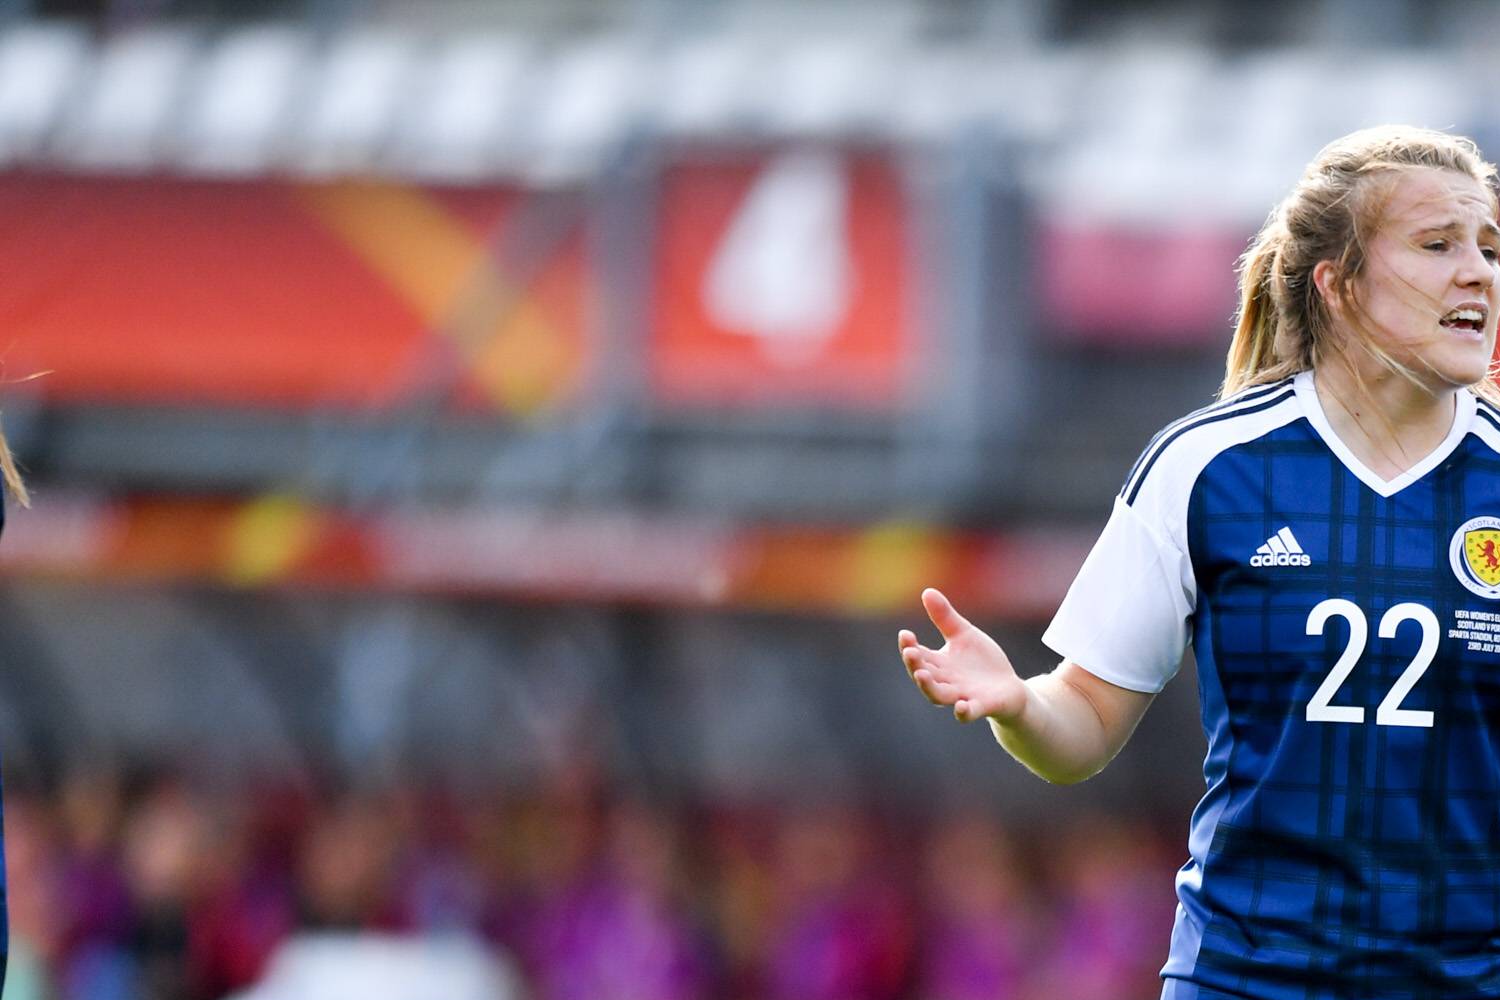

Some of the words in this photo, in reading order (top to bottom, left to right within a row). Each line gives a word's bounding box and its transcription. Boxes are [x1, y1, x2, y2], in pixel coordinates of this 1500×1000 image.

[1250, 552, 1311, 567] adidas
[1455, 610, 1469, 619] UEFA
[1457, 620, 1485, 631] SCOTLAND
[1448, 629, 1469, 639] SPARTA
[1482, 643, 1494, 652] JULY
[1306, 598, 1440, 728] 22
